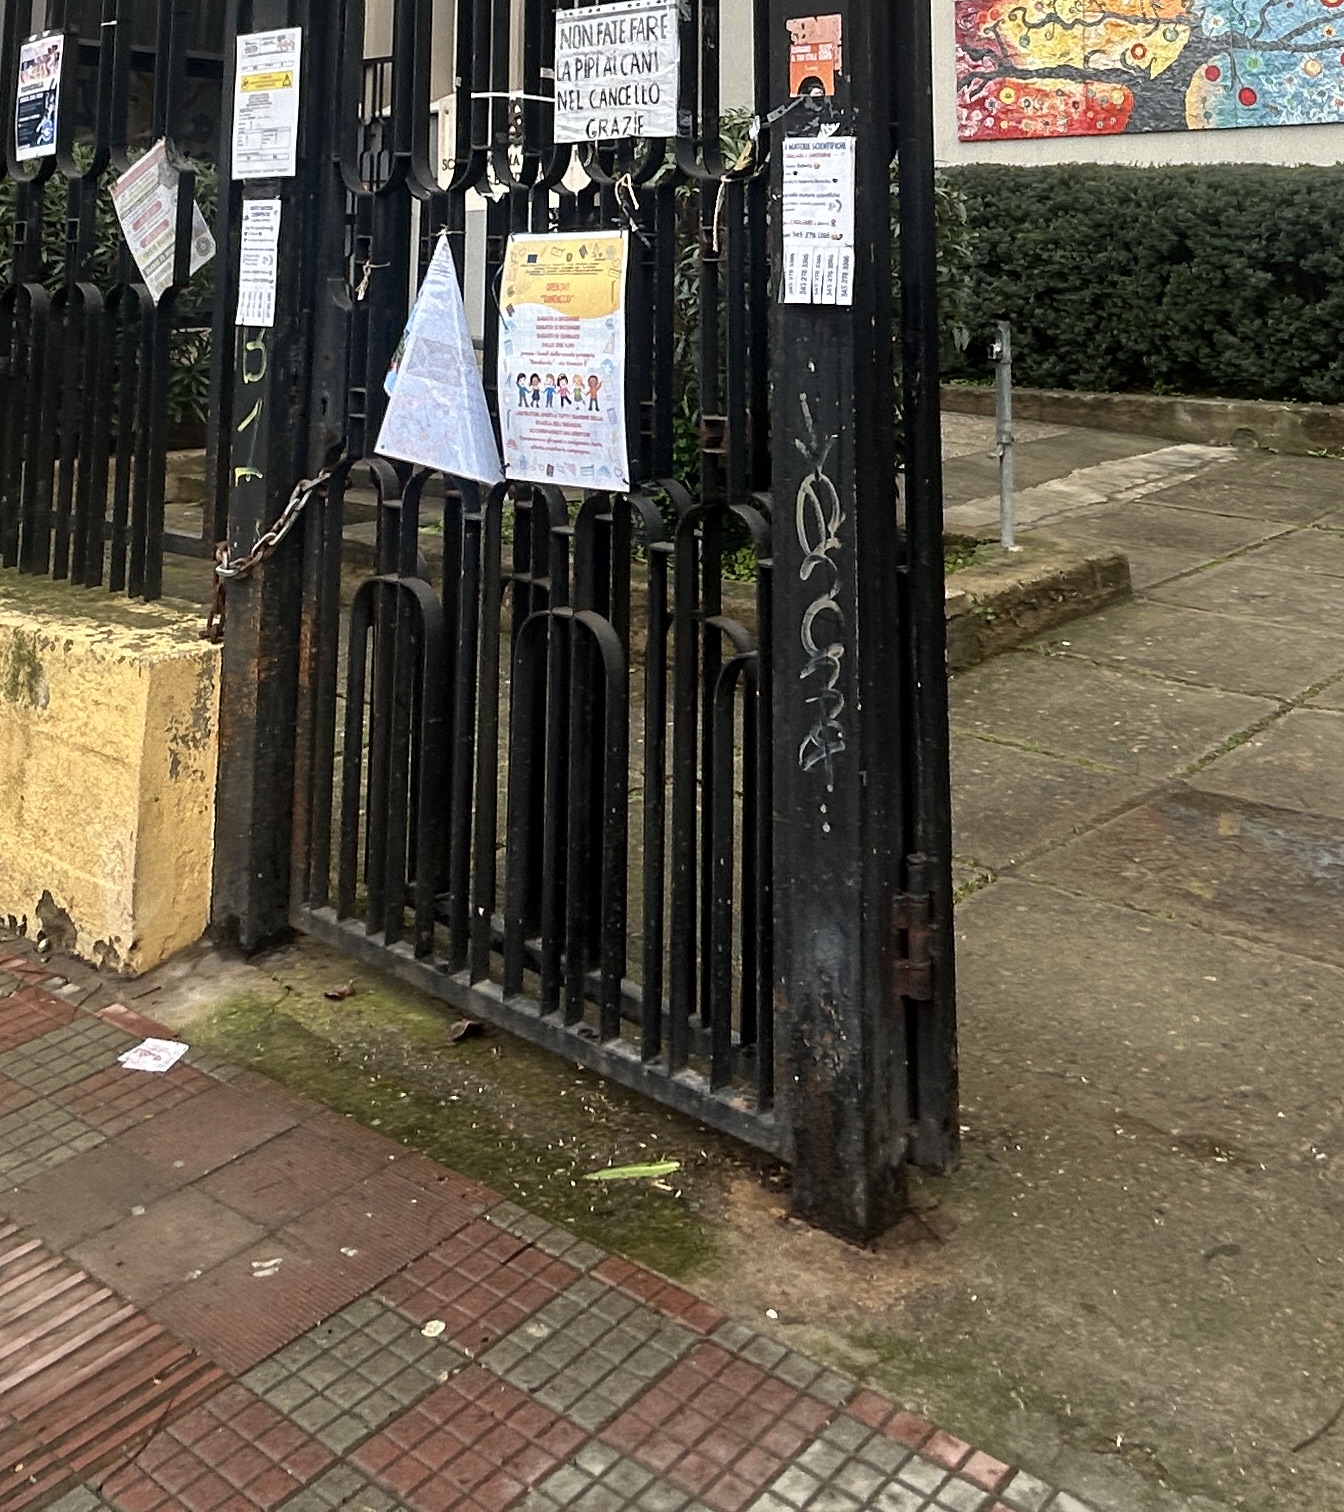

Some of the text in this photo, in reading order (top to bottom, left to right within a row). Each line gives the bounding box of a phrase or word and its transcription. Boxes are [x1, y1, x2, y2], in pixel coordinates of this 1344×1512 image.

[559, 13, 668, 50] NON FATE FARE
[556, 59, 571, 82] LA
[620, 46, 659, 77] CANI
[557, 82, 660, 112] NEL CANCELLO
